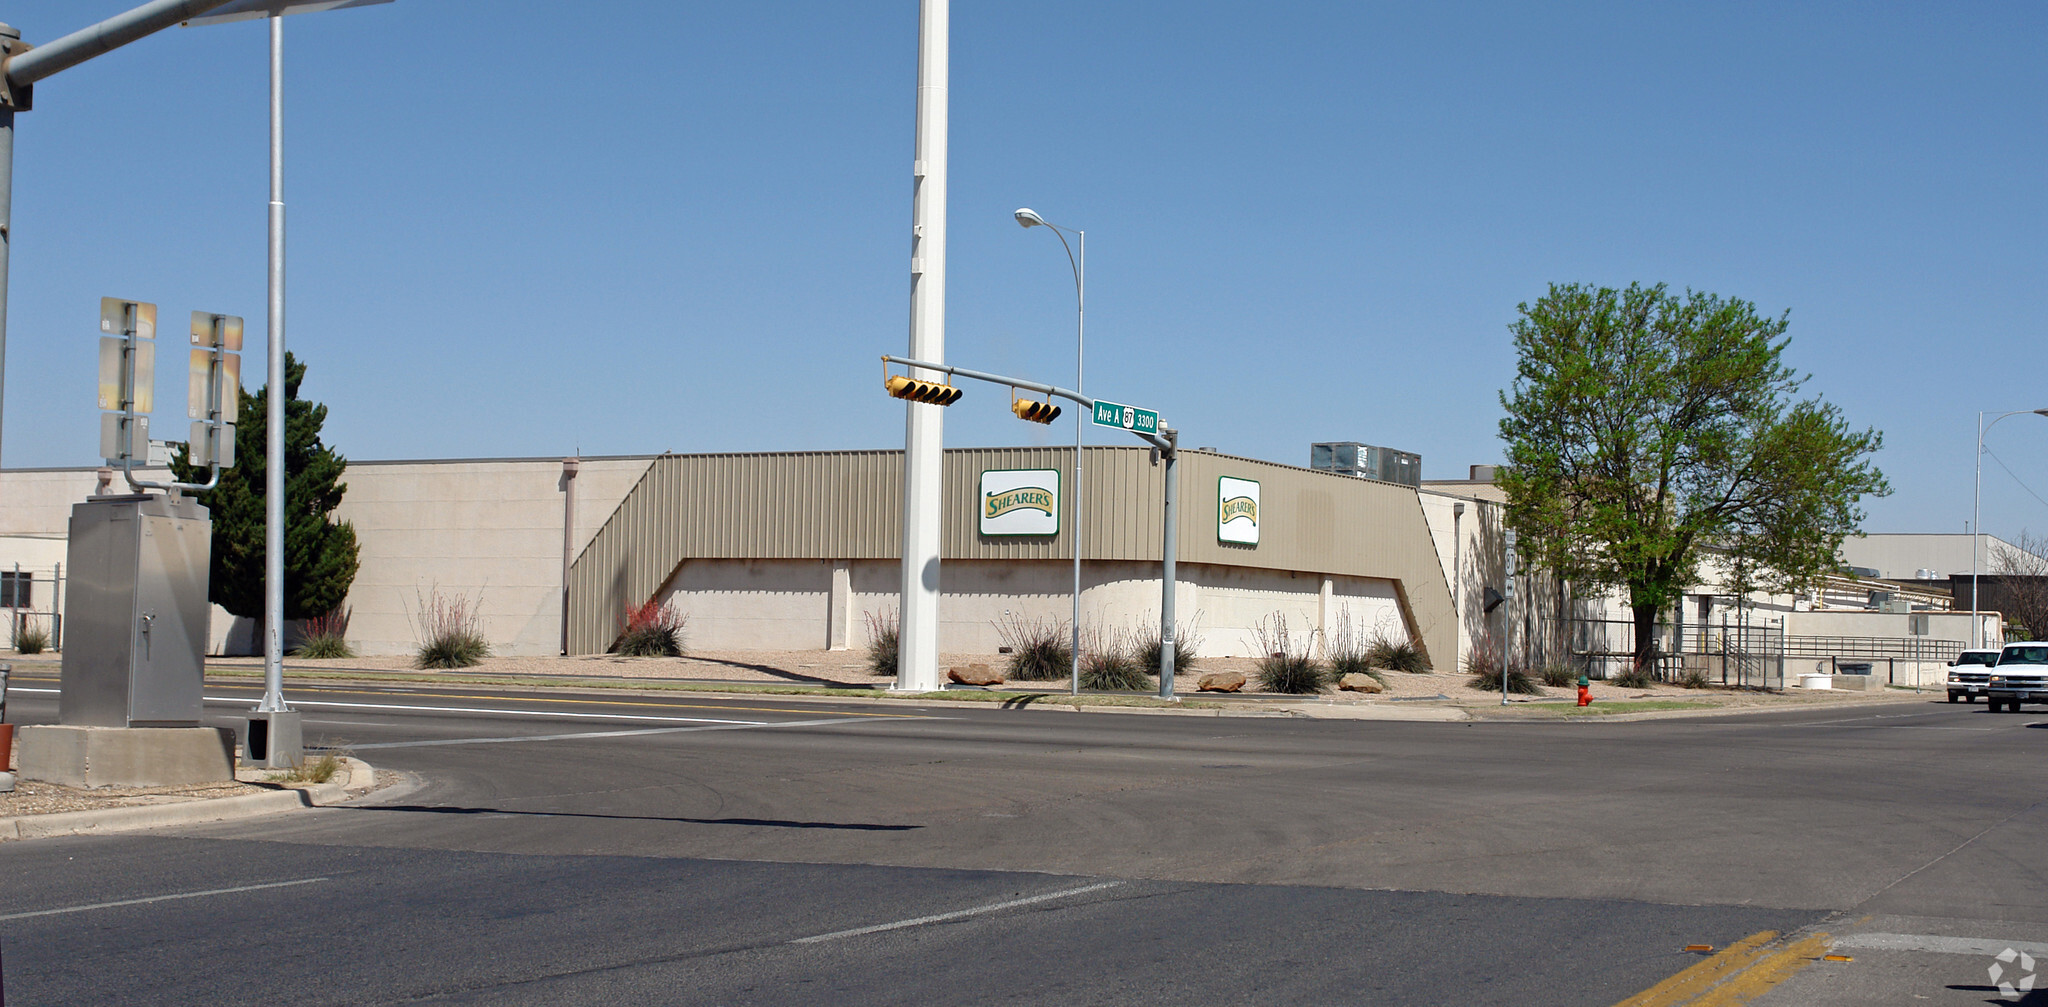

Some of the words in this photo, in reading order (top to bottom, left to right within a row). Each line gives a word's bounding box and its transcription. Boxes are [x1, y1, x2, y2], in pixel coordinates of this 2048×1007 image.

[1097, 405, 1112, 422] Ave
[1114, 408, 1120, 424] A
[1124, 411, 1133, 424] 87
[1137, 414, 1154, 429] 3300
[989, 492, 1050, 516] SHEARER'S
[1223, 502, 1255, 520] SHEARER'S
